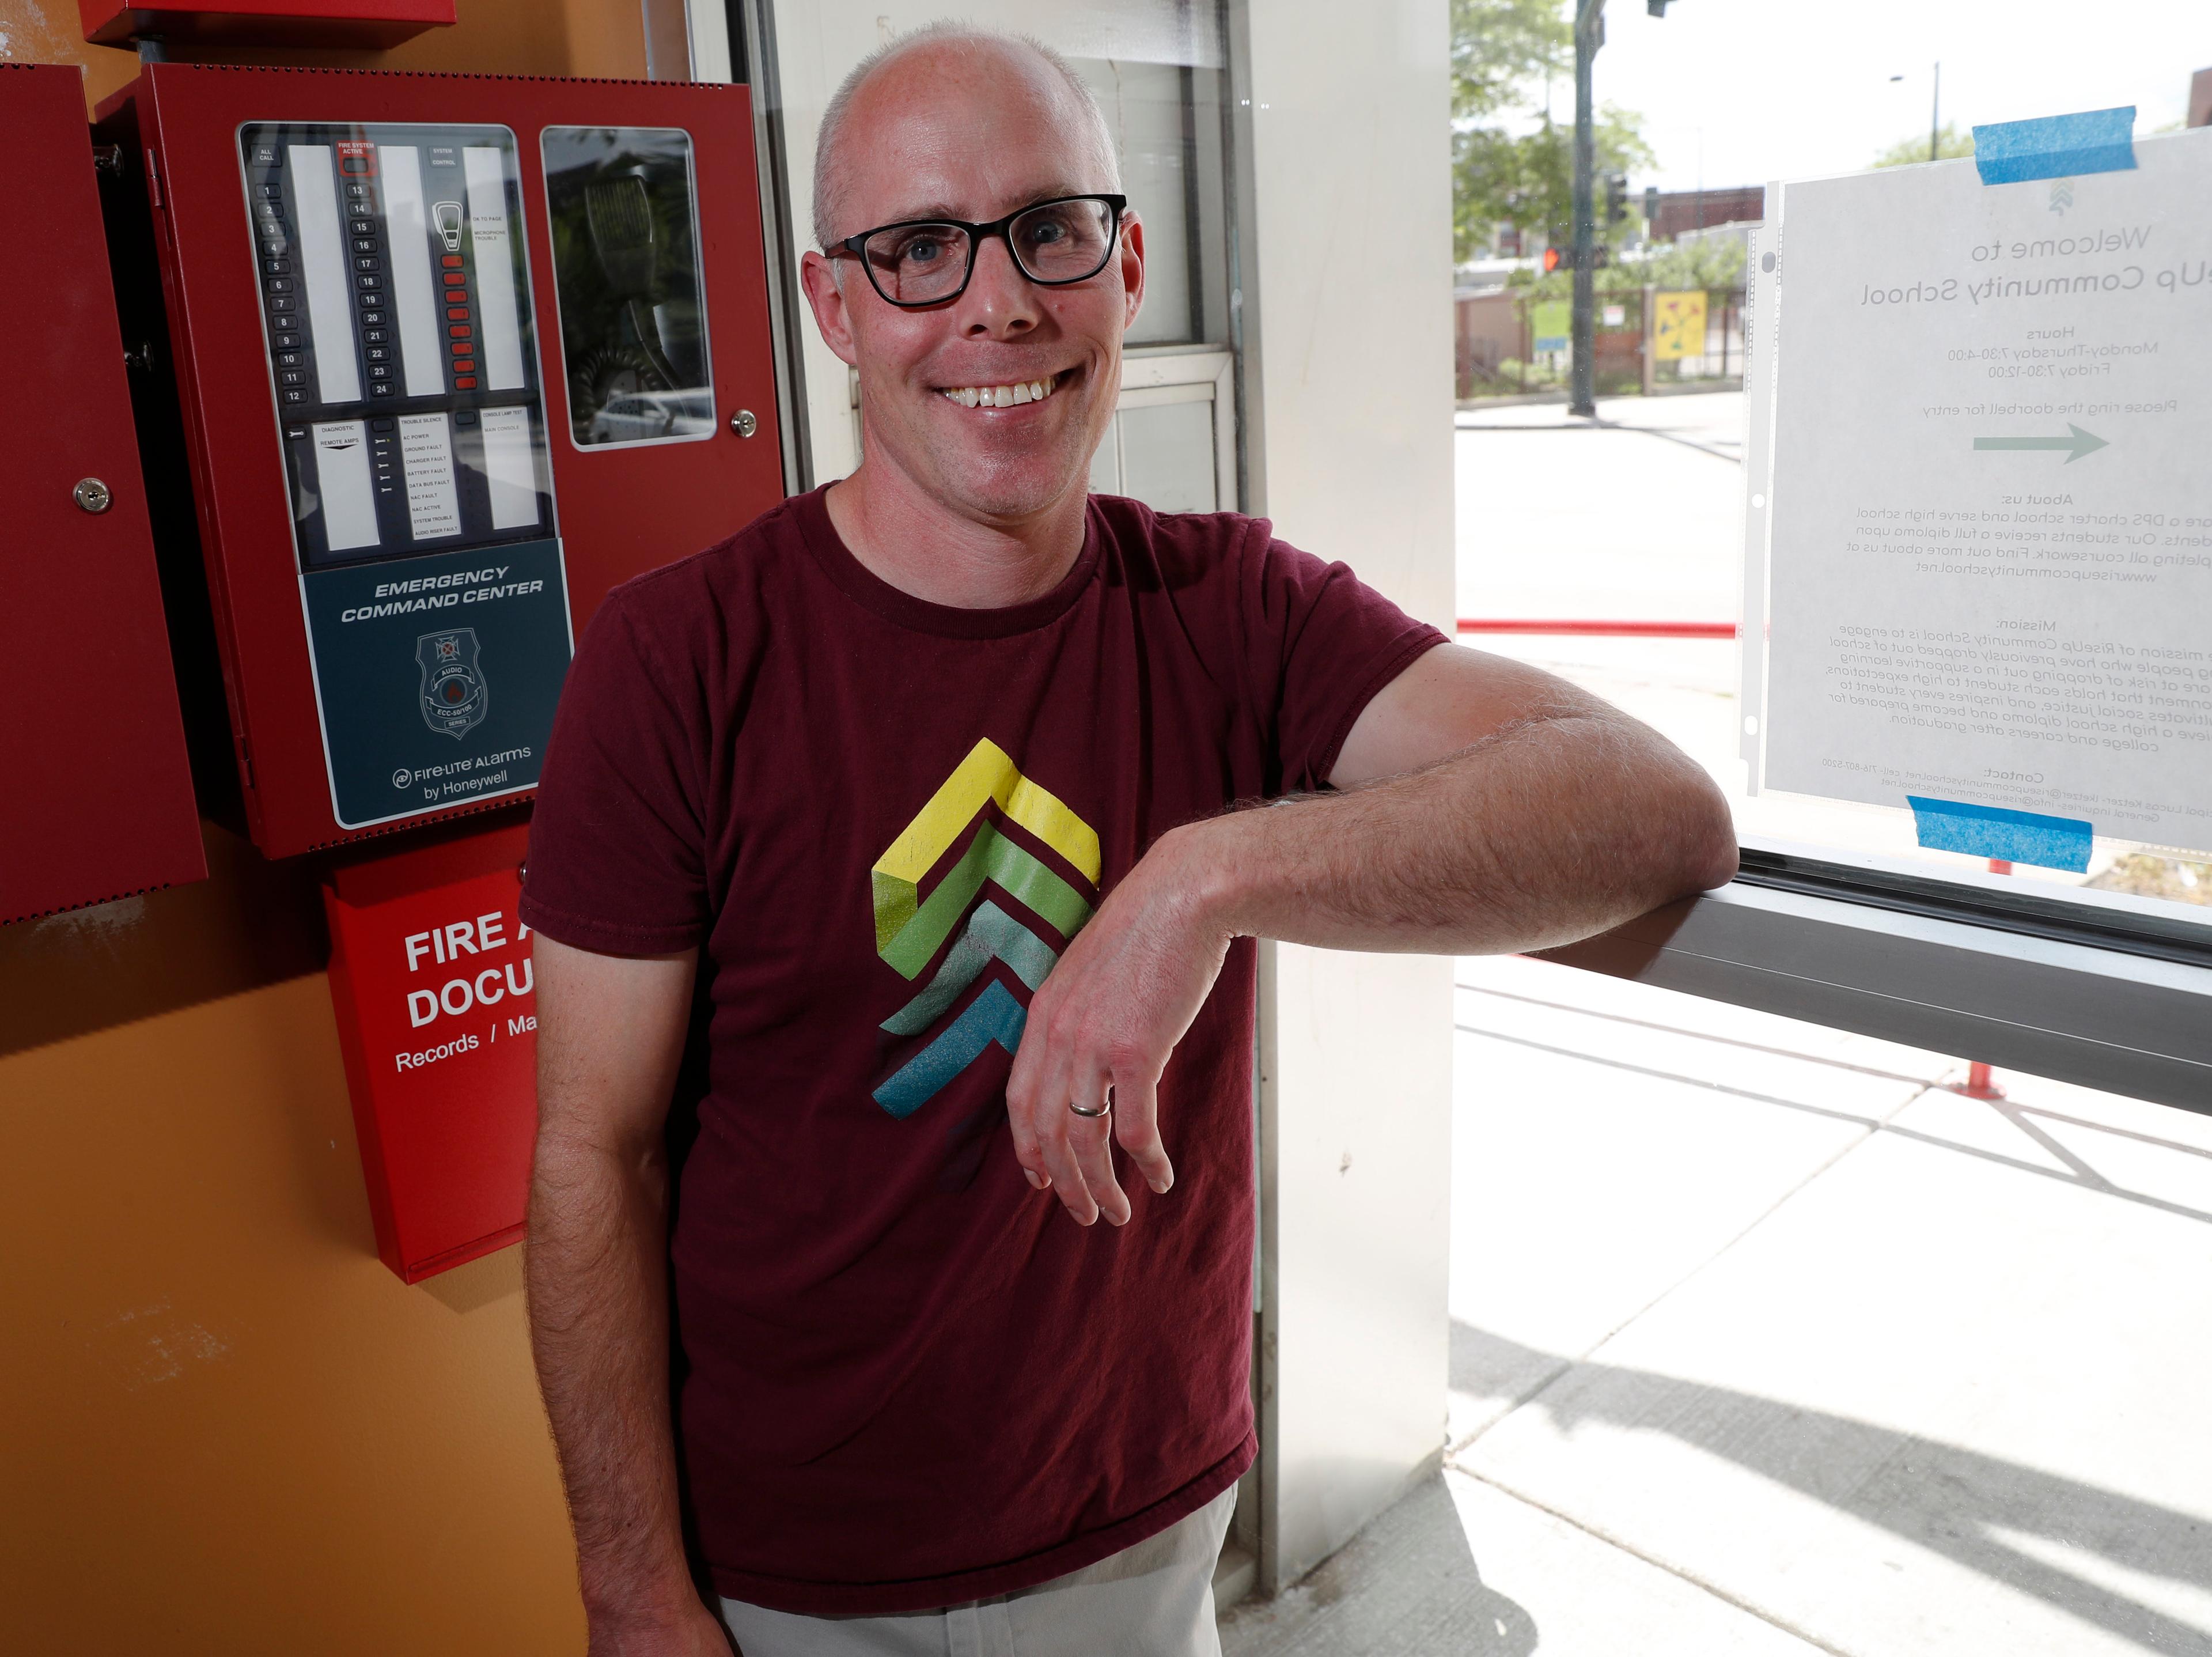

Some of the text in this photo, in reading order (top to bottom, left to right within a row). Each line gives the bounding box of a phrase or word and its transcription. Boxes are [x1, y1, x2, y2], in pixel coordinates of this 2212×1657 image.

[266, 206, 272, 214] 2
[269, 225, 274, 233] 3
[377, 385, 386, 393] 24
[289, 392, 299, 400] 12
[375, 566, 508, 597] EMERGENCY
[341, 580, 543, 622] COMMAND CENTER
[442, 667, 462, 676] AUDIO
[437, 704, 472, 716] ECC-50/100
[424, 769, 507, 800] by Honeywell
[405, 911, 506, 971] FIRE
[395, 1034, 479, 1072] Records
